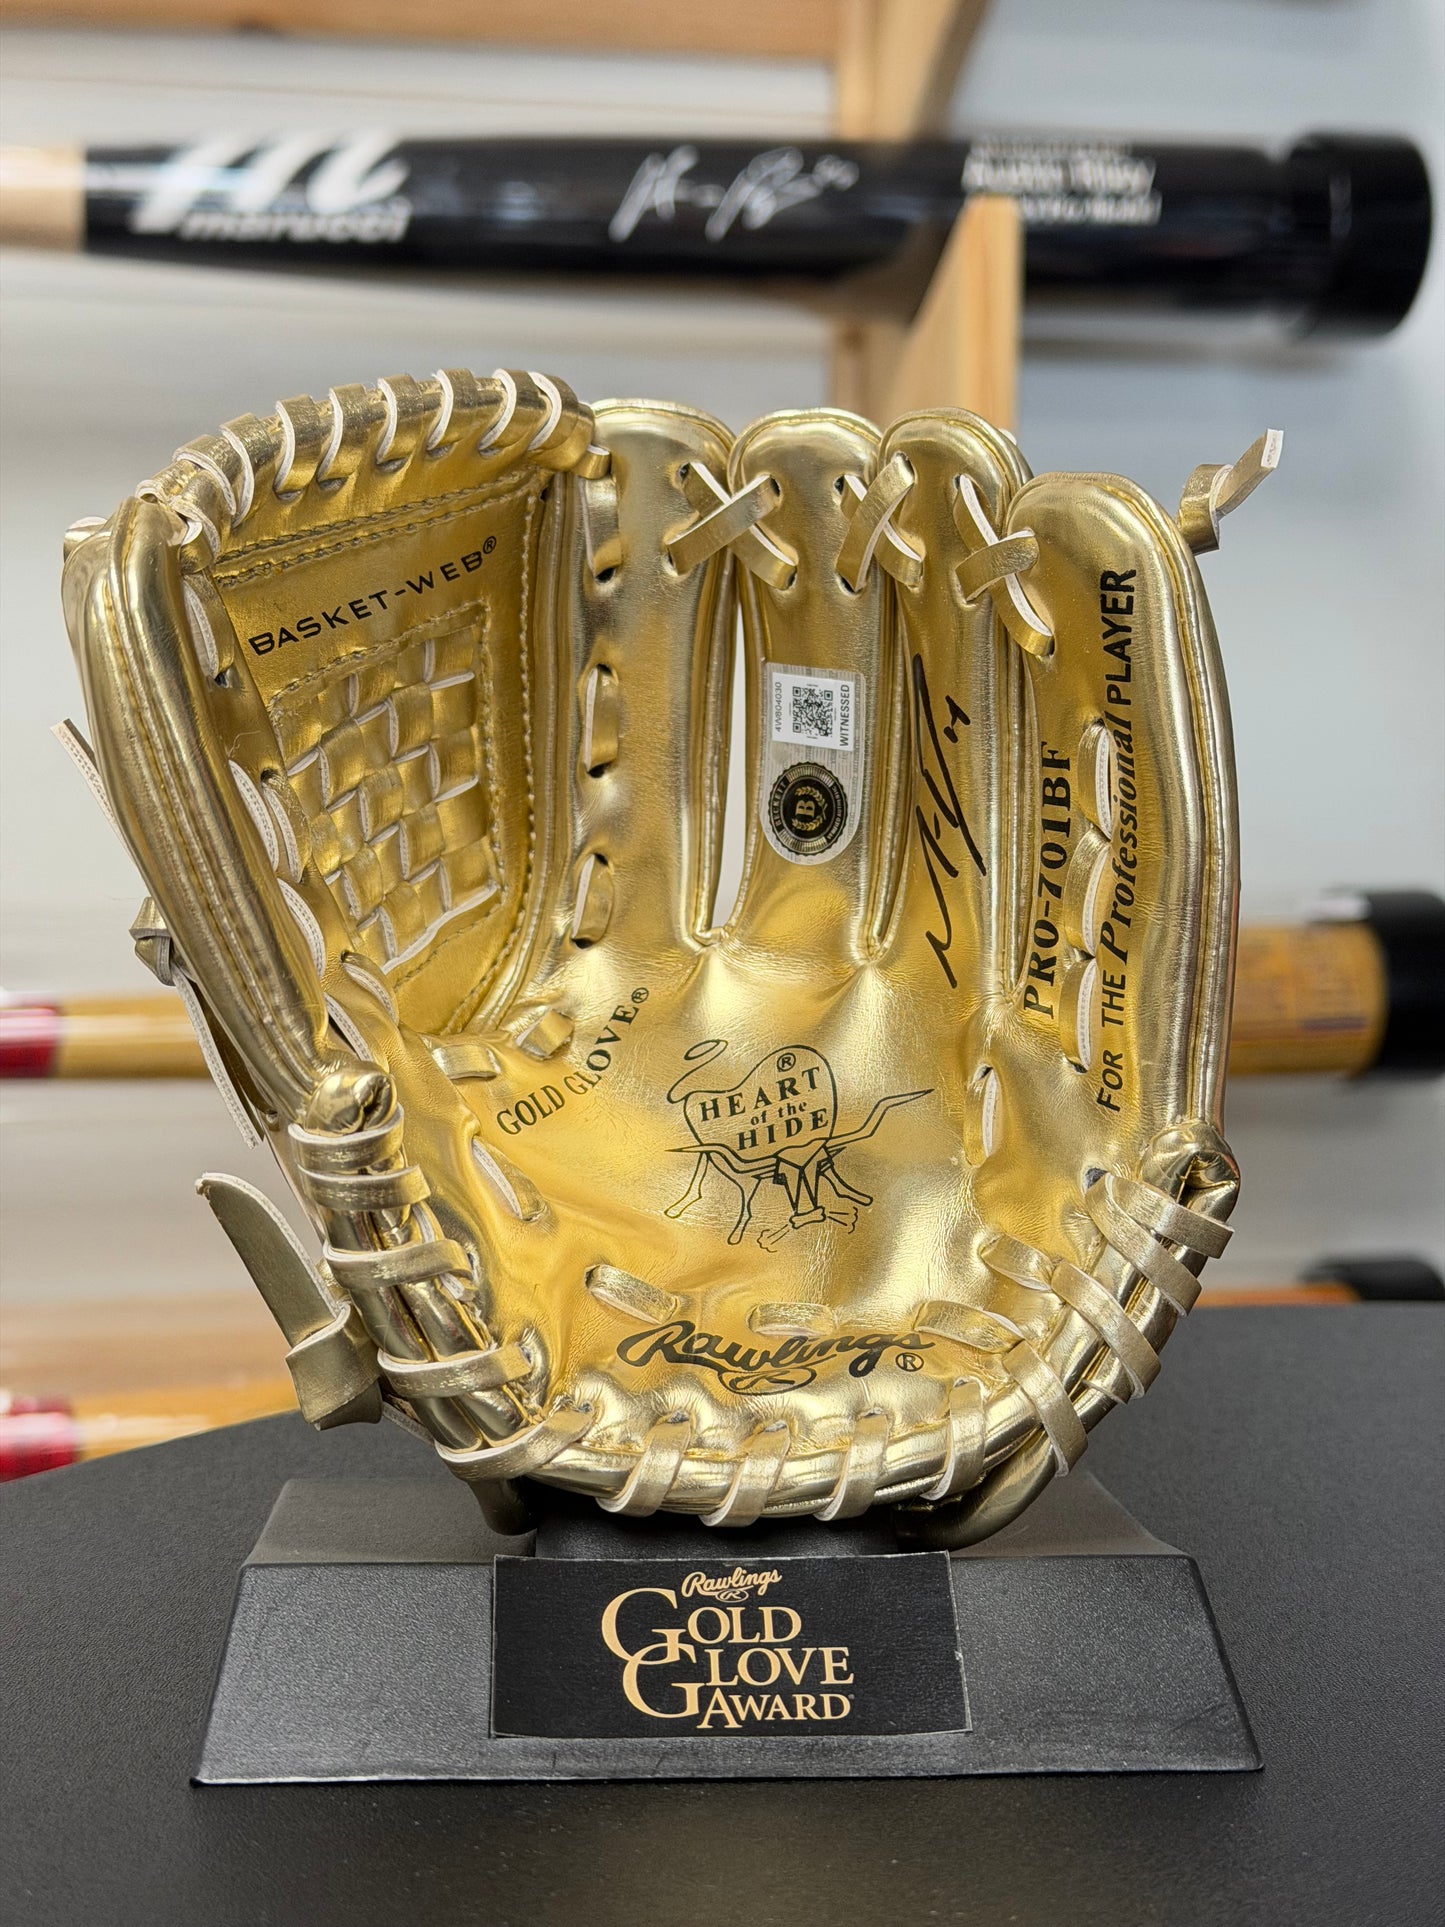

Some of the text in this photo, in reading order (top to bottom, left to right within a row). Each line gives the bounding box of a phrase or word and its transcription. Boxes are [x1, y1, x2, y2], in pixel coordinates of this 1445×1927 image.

[839, 684, 850, 747] WITNESSED
[1096, 569, 1138, 1112] FOR THE Professional PLAYER
[1023, 740, 1071, 1020] PRO-701BF
[496, 1084, 566, 1135] GOLD
[698, 1066, 820, 1122] HEART
[750, 1101, 808, 1126] of the
[736, 1107, 829, 1151] HIDE
[616, 1320, 936, 1390] Rawlings
[681, 1566, 783, 1600] Rawlings
[601, 1587, 802, 1665] GOLD
[622, 1643, 855, 1719] GLOVE
[696, 1687, 851, 1729] AWARD
